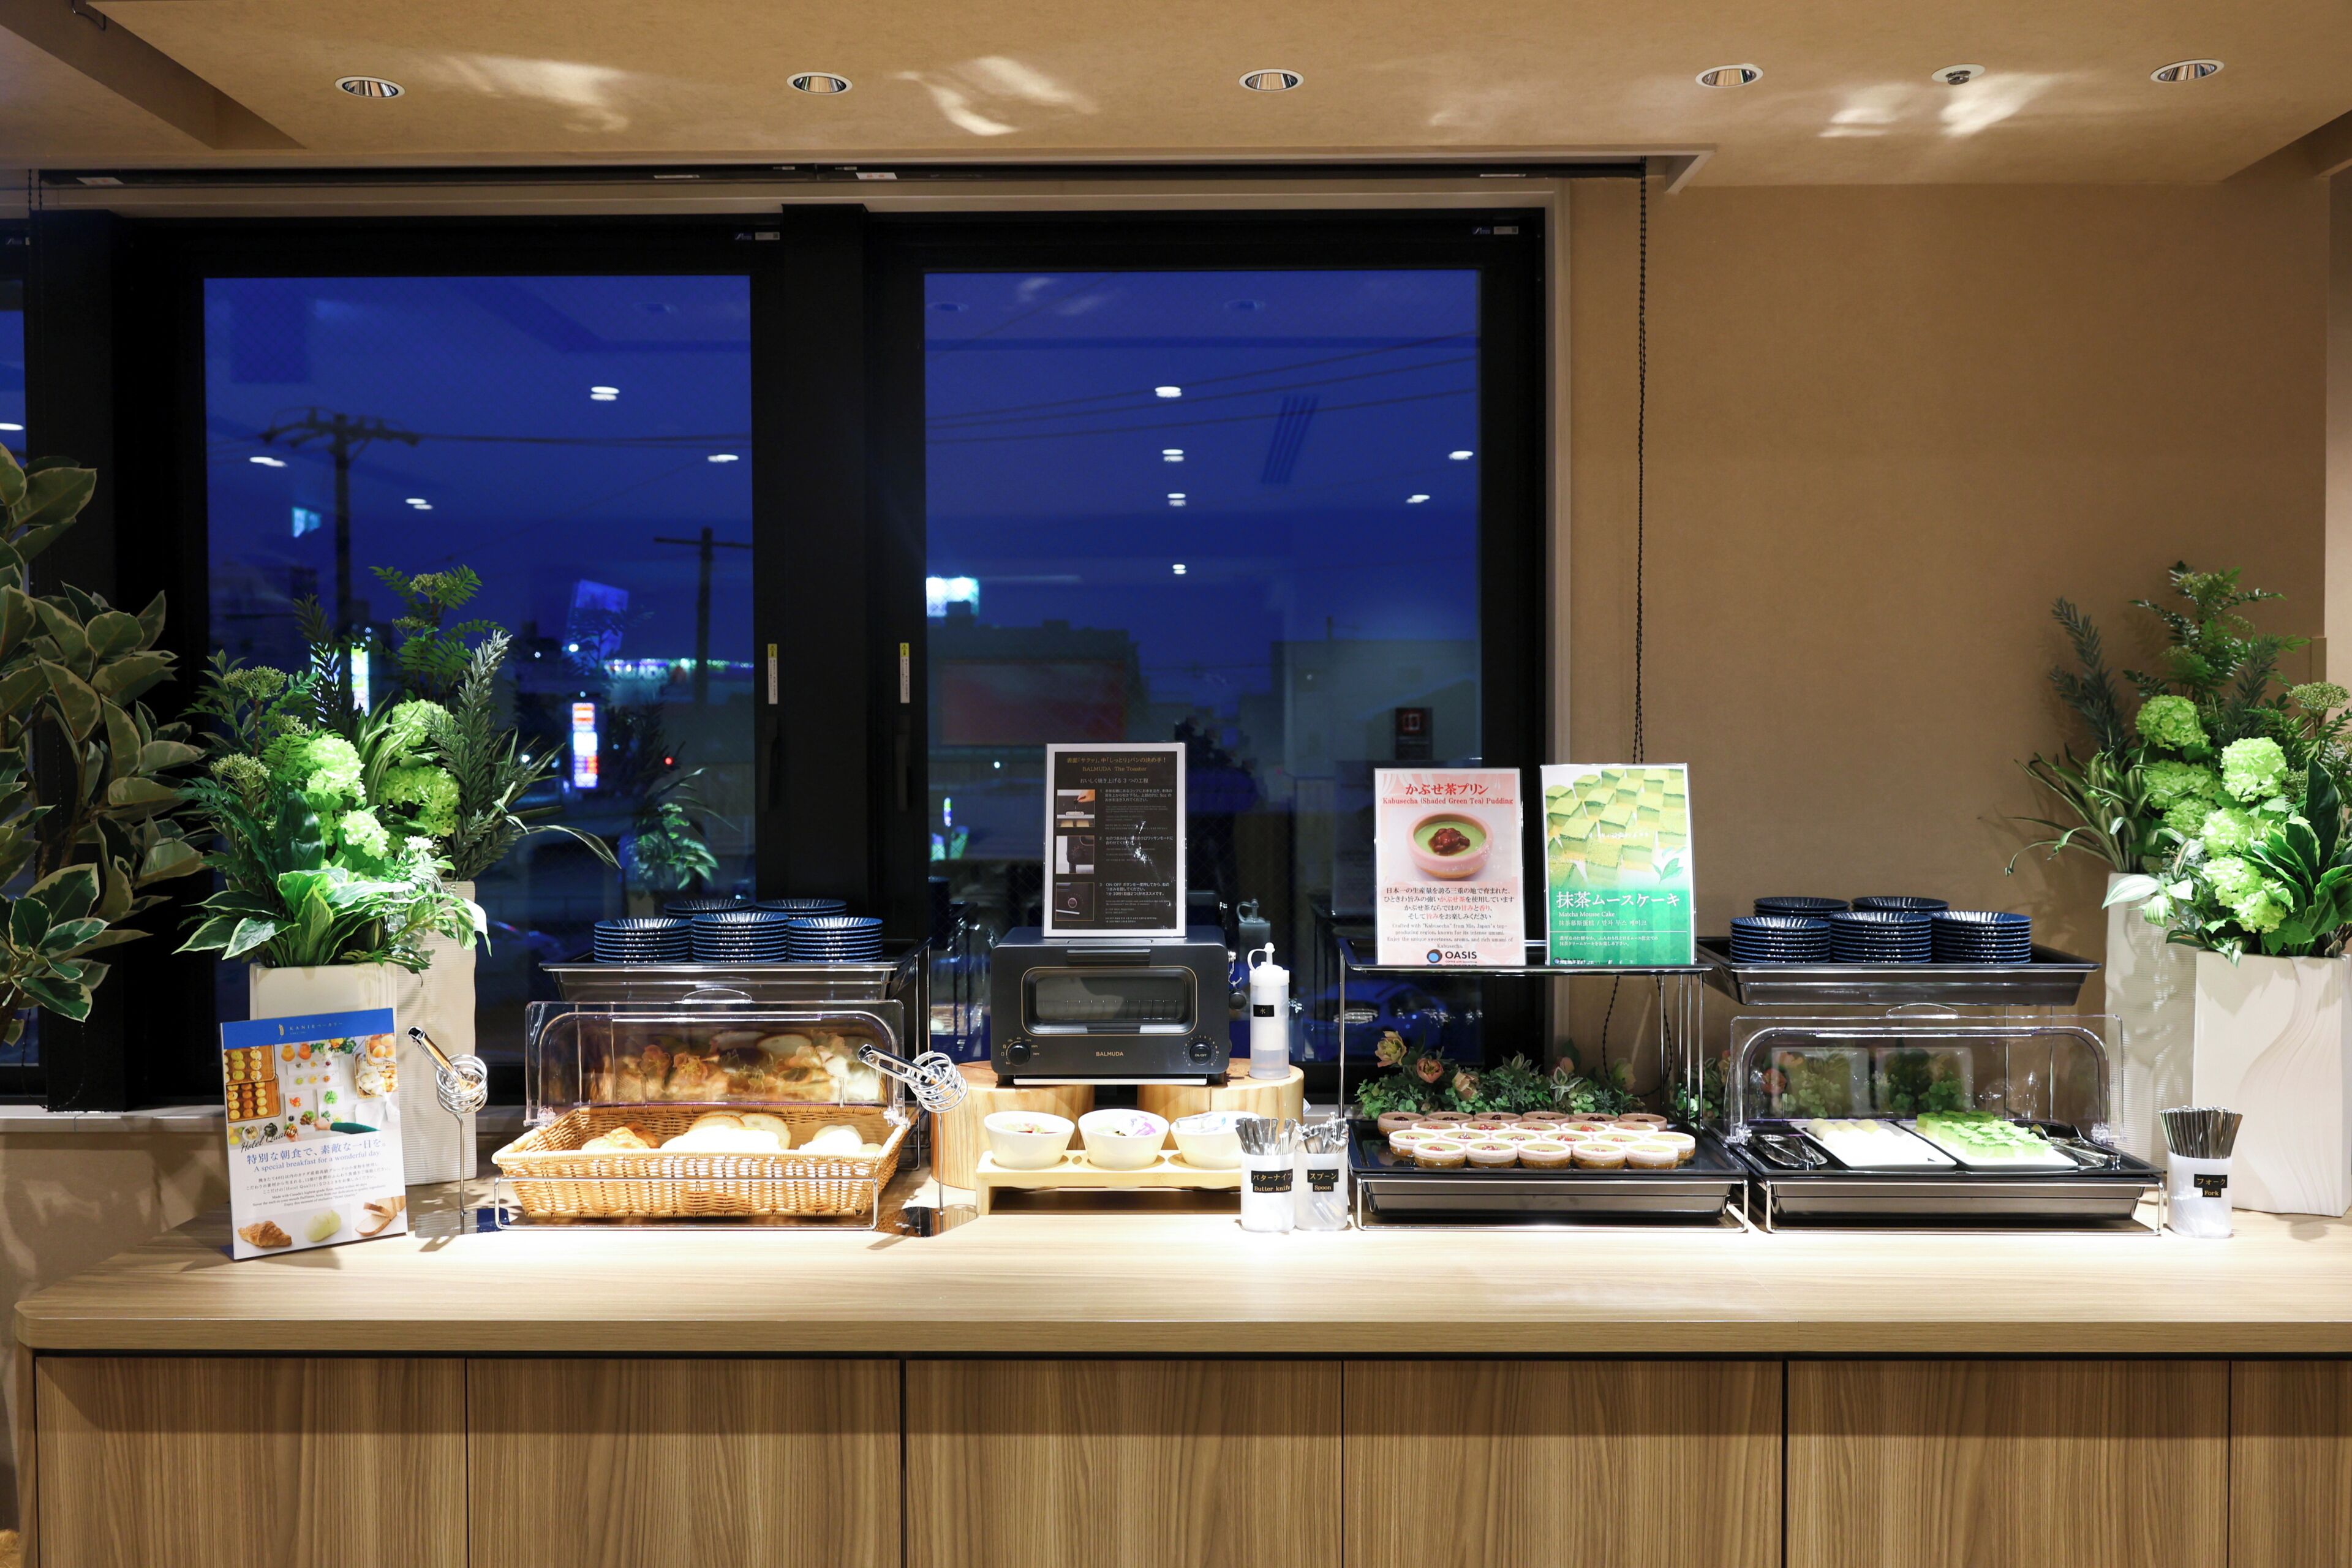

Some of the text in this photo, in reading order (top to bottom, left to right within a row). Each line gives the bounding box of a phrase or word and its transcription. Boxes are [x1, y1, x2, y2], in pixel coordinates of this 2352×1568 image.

[1405, 783, 1489, 795] かぶせ茶プリン
[1556, 891, 1680, 908] 抹茶ムースケーキ
[240, 1126, 298, 1153] Hotel Quality
[246, 1139, 386, 1165] 特別な朝食で、素敵な一日を。
[261, 1163, 285, 1172] special
[286, 1158, 317, 1169] breakfast
[334, 1152, 368, 1161] wonderful
[369, 1150, 381, 1159] day.
